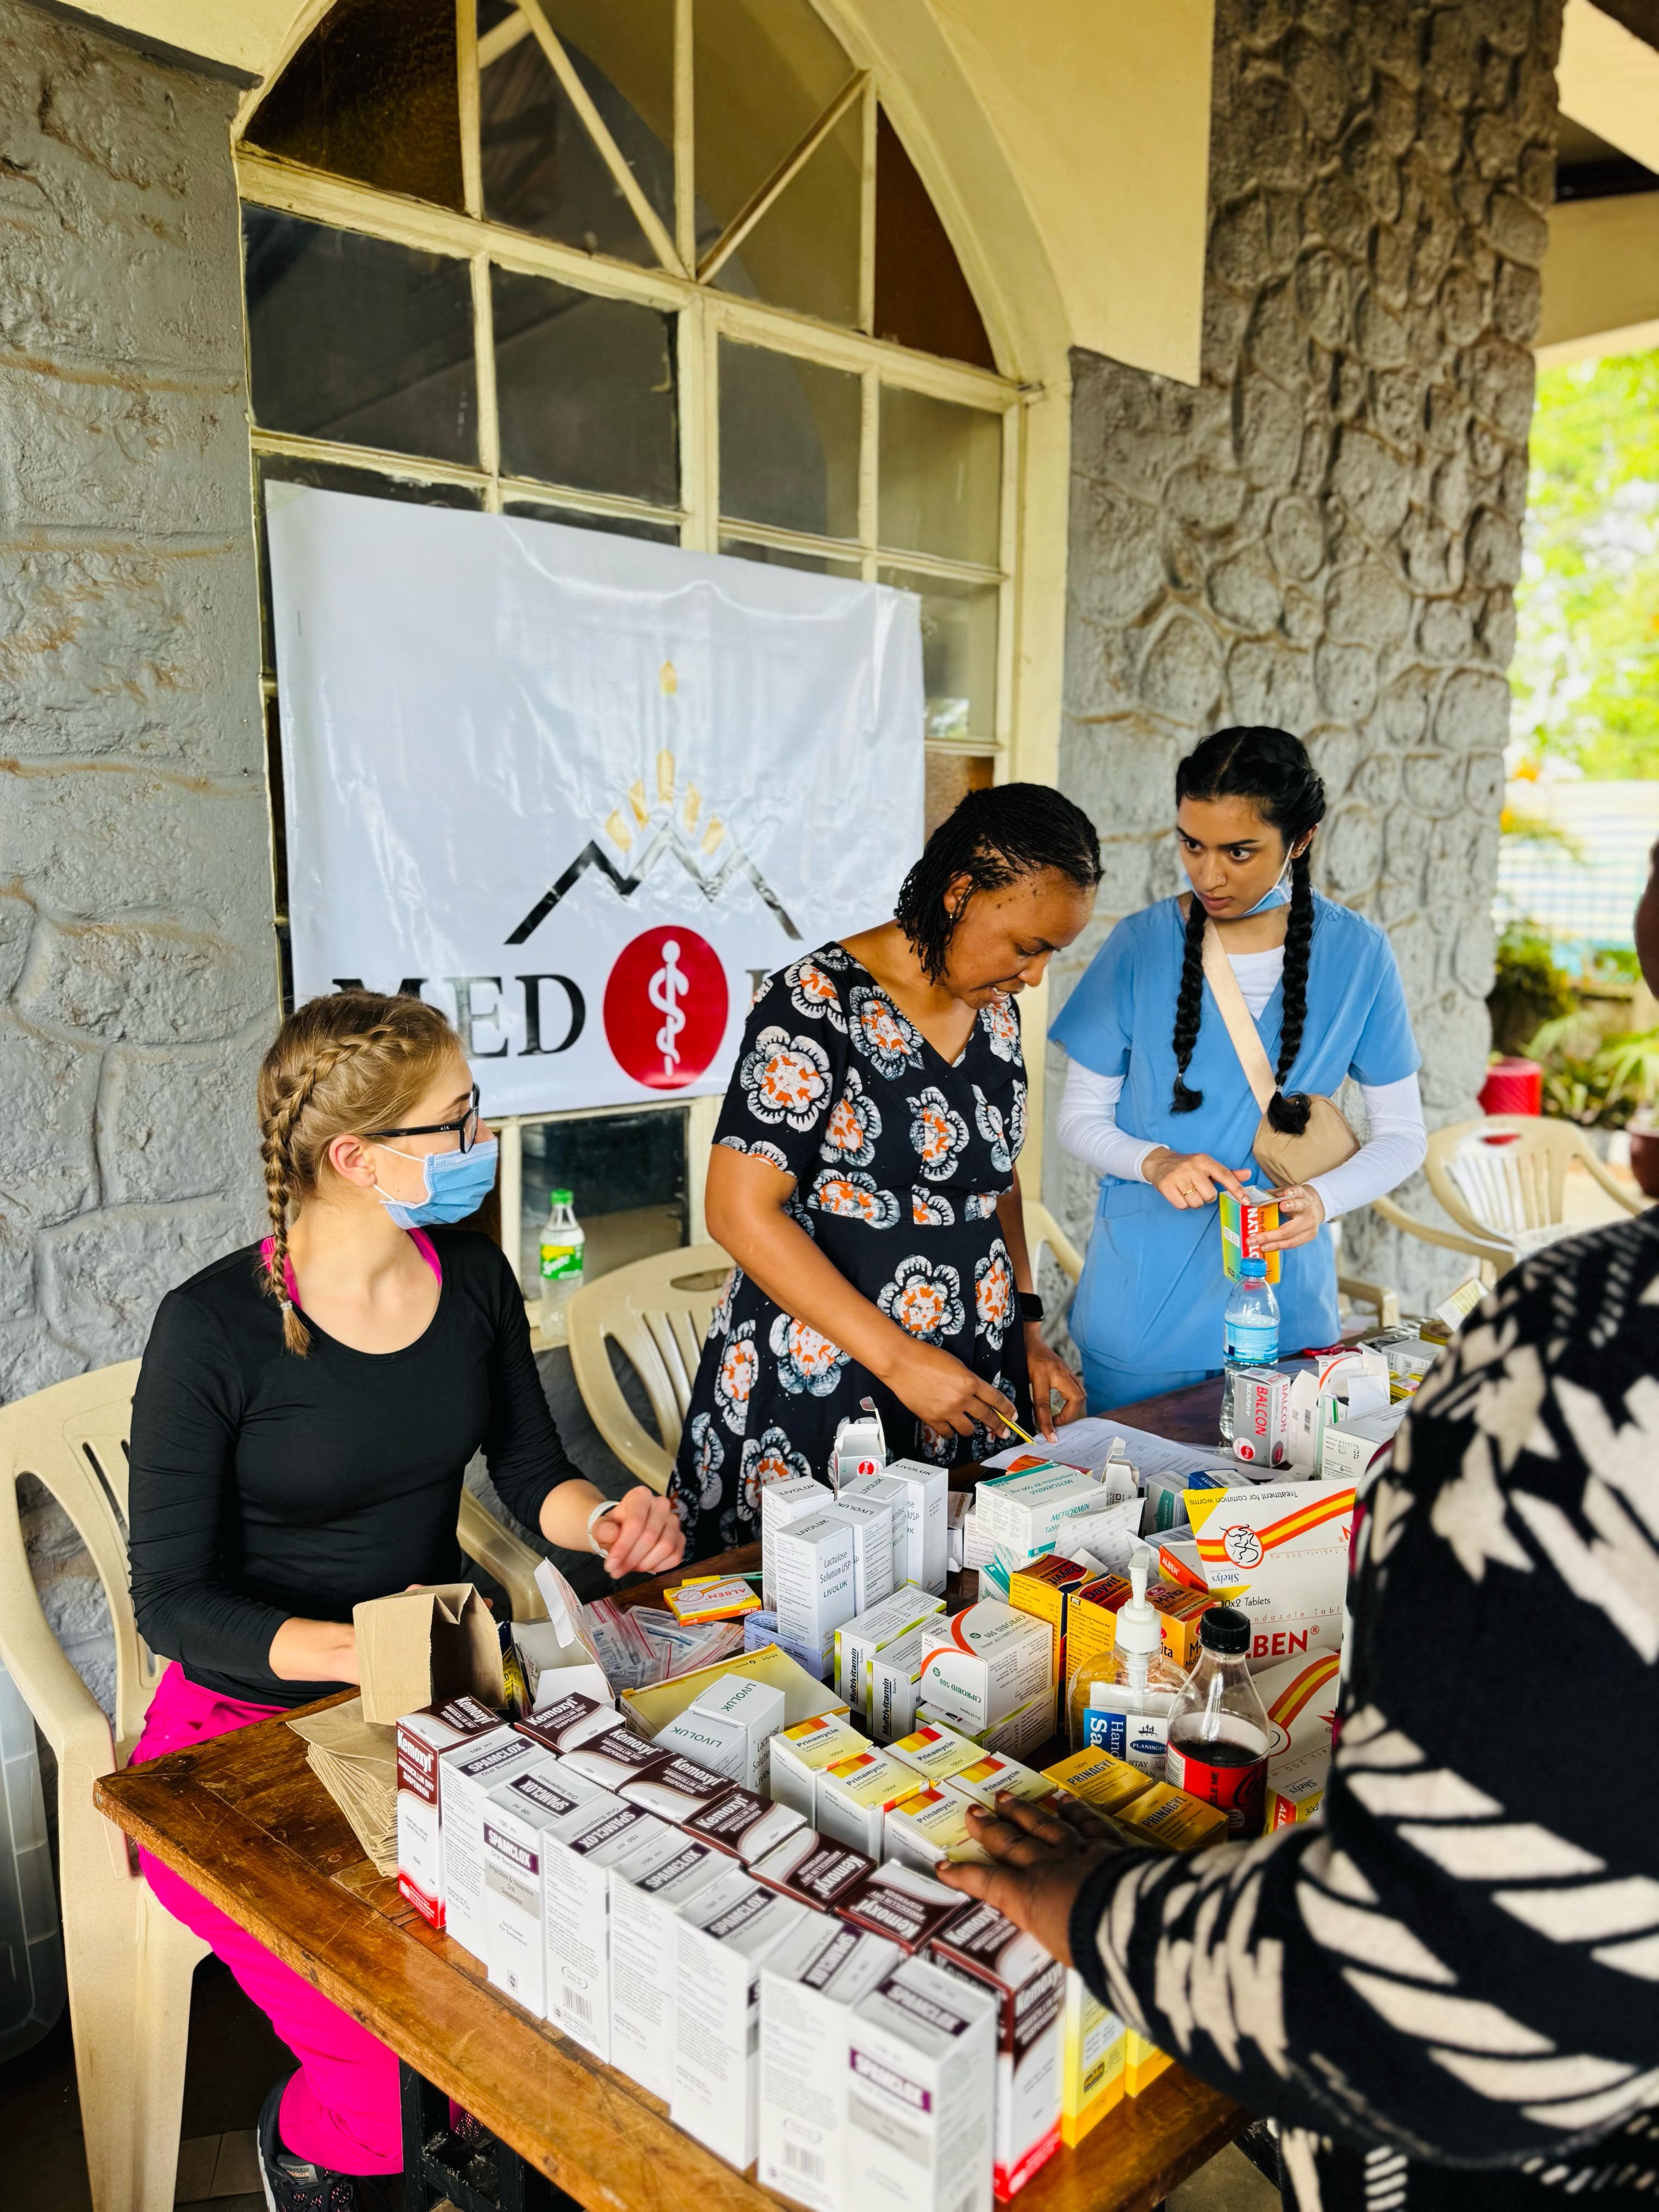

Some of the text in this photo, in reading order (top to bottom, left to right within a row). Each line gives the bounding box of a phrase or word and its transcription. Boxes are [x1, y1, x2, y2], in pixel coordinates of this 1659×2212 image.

[332, 974, 586, 1060] ED
[1255, 1385, 1268, 1437] BALCON
[1280, 1383, 1289, 1433] BALCON
[895, 1463, 933, 1476] LIVOLUK
[778, 1483, 818, 1496] LIVOLUK
[860, 1477, 885, 1494] LIVOLUK
[1029, 1479, 1074, 1495] METFORMINA
[837, 1502, 874, 1515] LIVOLUK
[1189, 1490, 1299, 1506] Treatment for common worms
[1050, 1502, 1090, 1523] METFORMIN
[795, 1518, 830, 1536] LIVOLUK
[824, 1551, 848, 1569] Lactulose
[820, 1560, 851, 1584] Solution USP
[1047, 1563, 1084, 1587] Dayvit
[1211, 1572, 1239, 1584] Shelys
[823, 1579, 848, 1598] LIVOLUK
[1082, 1575, 1122, 1601] Dayvit
[1244, 1597, 1271, 1607] Tablets
[995, 1614, 1026, 1632] CIPROBID
[720, 1682, 758, 1712] LIVOLUK
[939, 1678, 981, 1704] CIPROBID 500
[444, 1705, 467, 1724] AMOXICILLIN
[544, 1704, 587, 1730] AMOXICILLIN DRY
[882, 1678, 891, 1736] Multivitamin
[441, 1710, 465, 1729] SUSPENSION
[554, 1710, 588, 1730] SUSPENSION
[670, 1726, 723, 1748] LIVOLUK
[796, 1728, 840, 1748] Prinamycin
[468, 1742, 526, 1773] SPAMCLOX
[600, 1745, 631, 1763] SUSPENSION
[601, 1739, 644, 1762] AMOXICILLIN DRY
[917, 1740, 956, 1762] Prinamycin
[398, 1756, 435, 1792] AMOXICILLIN DRY
[481, 1768, 495, 1777] Oral
[845, 1762, 888, 1786] Prinamycin
[1066, 1758, 1116, 1786] PRINAGYL
[1128, 1759, 1149, 1768] STAY
[403, 1770, 430, 1799] SUSPENSION
[663, 1769, 709, 1793] AMOXICILLIN DRY
[663, 1775, 696, 1794] SUSPENSION
[981, 1769, 1021, 1792] Prinamycin
[1211, 1771, 1219, 1785] ME
[1289, 1779, 1318, 1794] Shelys
[520, 1779, 569, 1811] SPAMCLOX
[566, 1790, 578, 1800] Oral
[607, 1807, 619, 1817] Oral
[718, 1802, 760, 1833] AMOXICILLIN DRY
[730, 1809, 763, 1832] SUSPENSION
[916, 1800, 958, 1824] Prinamycin
[1141, 1795, 1188, 1829] PRINAGYL
[578, 1811, 636, 1849] SPAMCLOX
[488, 1829, 531, 1868] SPAMCLOX
[491, 1849, 501, 1861] Oral
[645, 1849, 702, 1888] SPAMCLOX
[798, 1851, 829, 1875] SUSPENSION
[663, 1882, 676, 1892] Oral
[883, 1888, 924, 1912] SUSPENSION
[710, 1893, 769, 1936] SPAMCLOX
